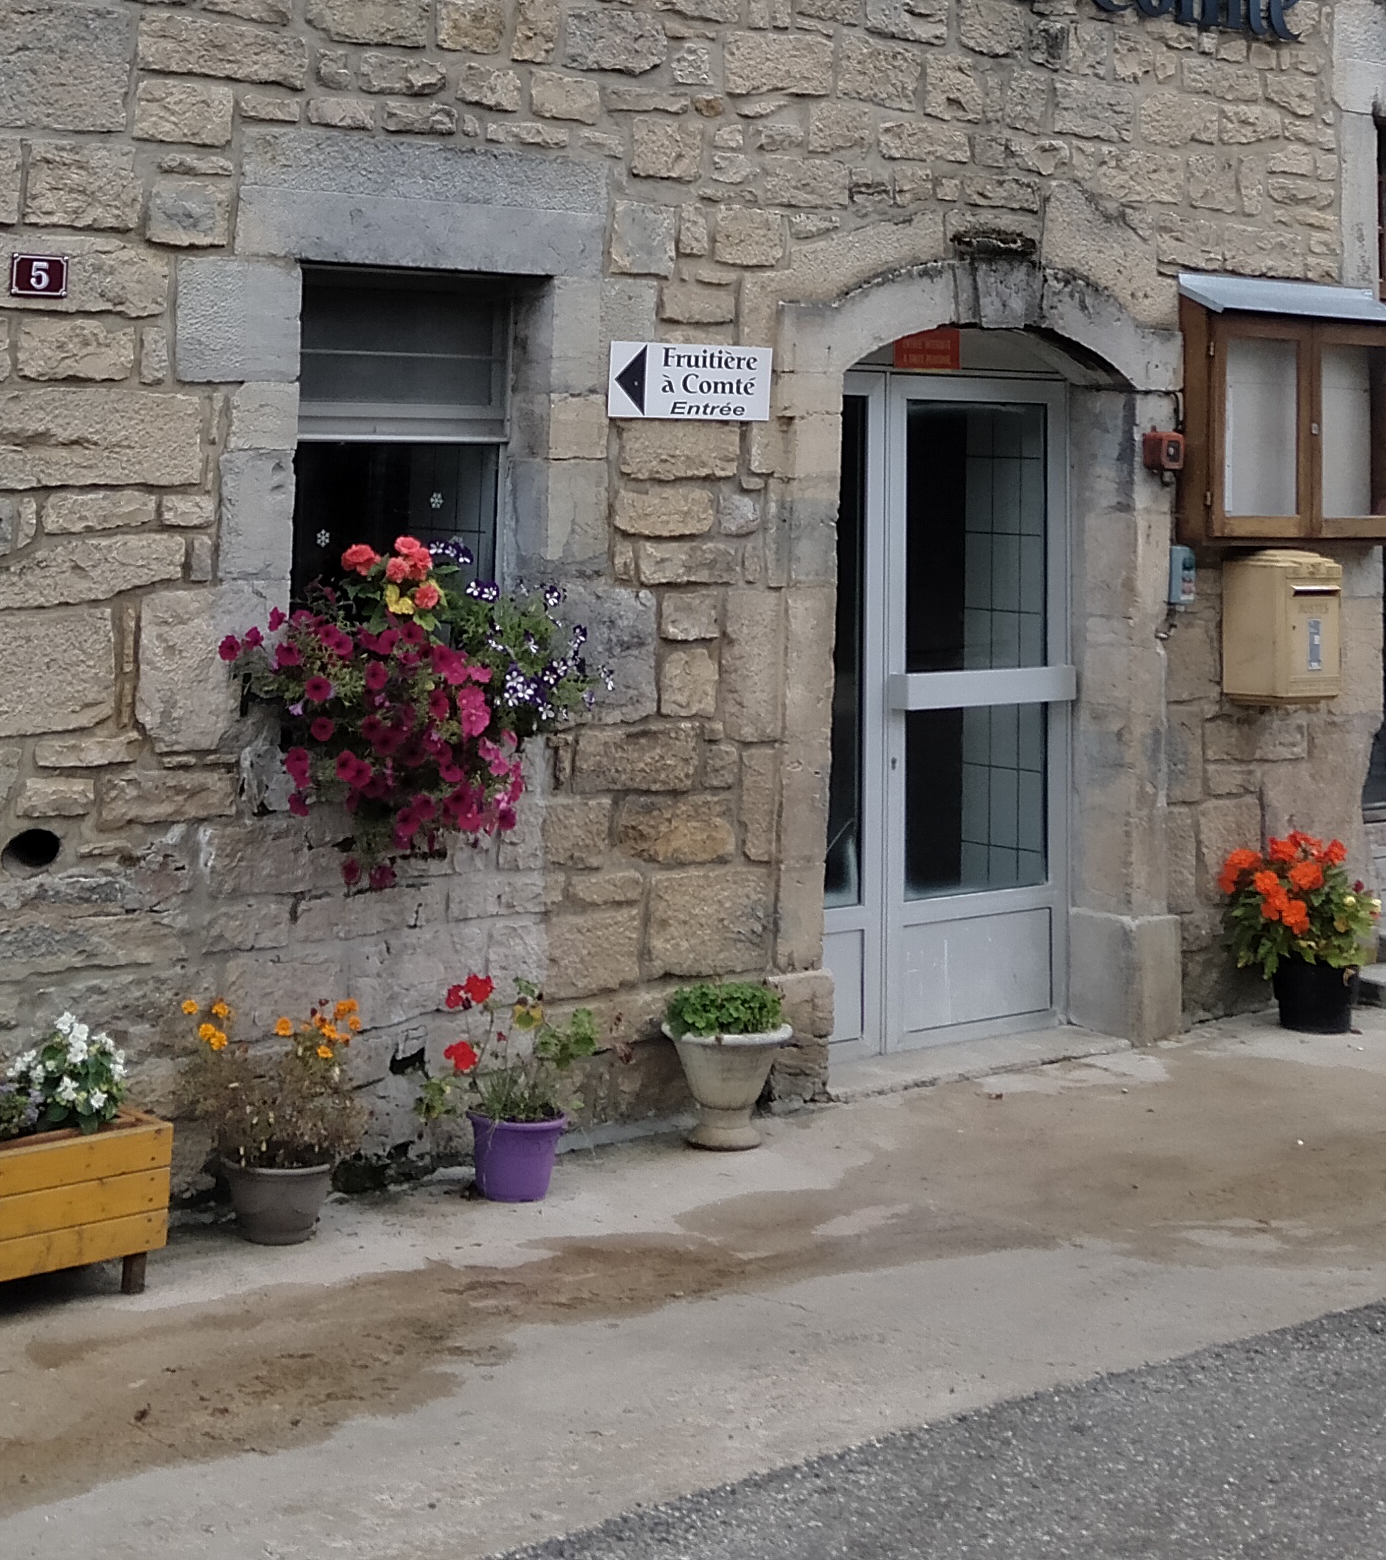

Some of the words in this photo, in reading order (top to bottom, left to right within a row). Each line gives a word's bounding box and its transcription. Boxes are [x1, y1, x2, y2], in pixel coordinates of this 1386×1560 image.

[30, 261, 49, 290] 5
[663, 347, 758, 370] Fruitière
[661, 374, 675, 393] à
[682, 373, 755, 395] Comté
[670, 401, 745, 416] Entrée
